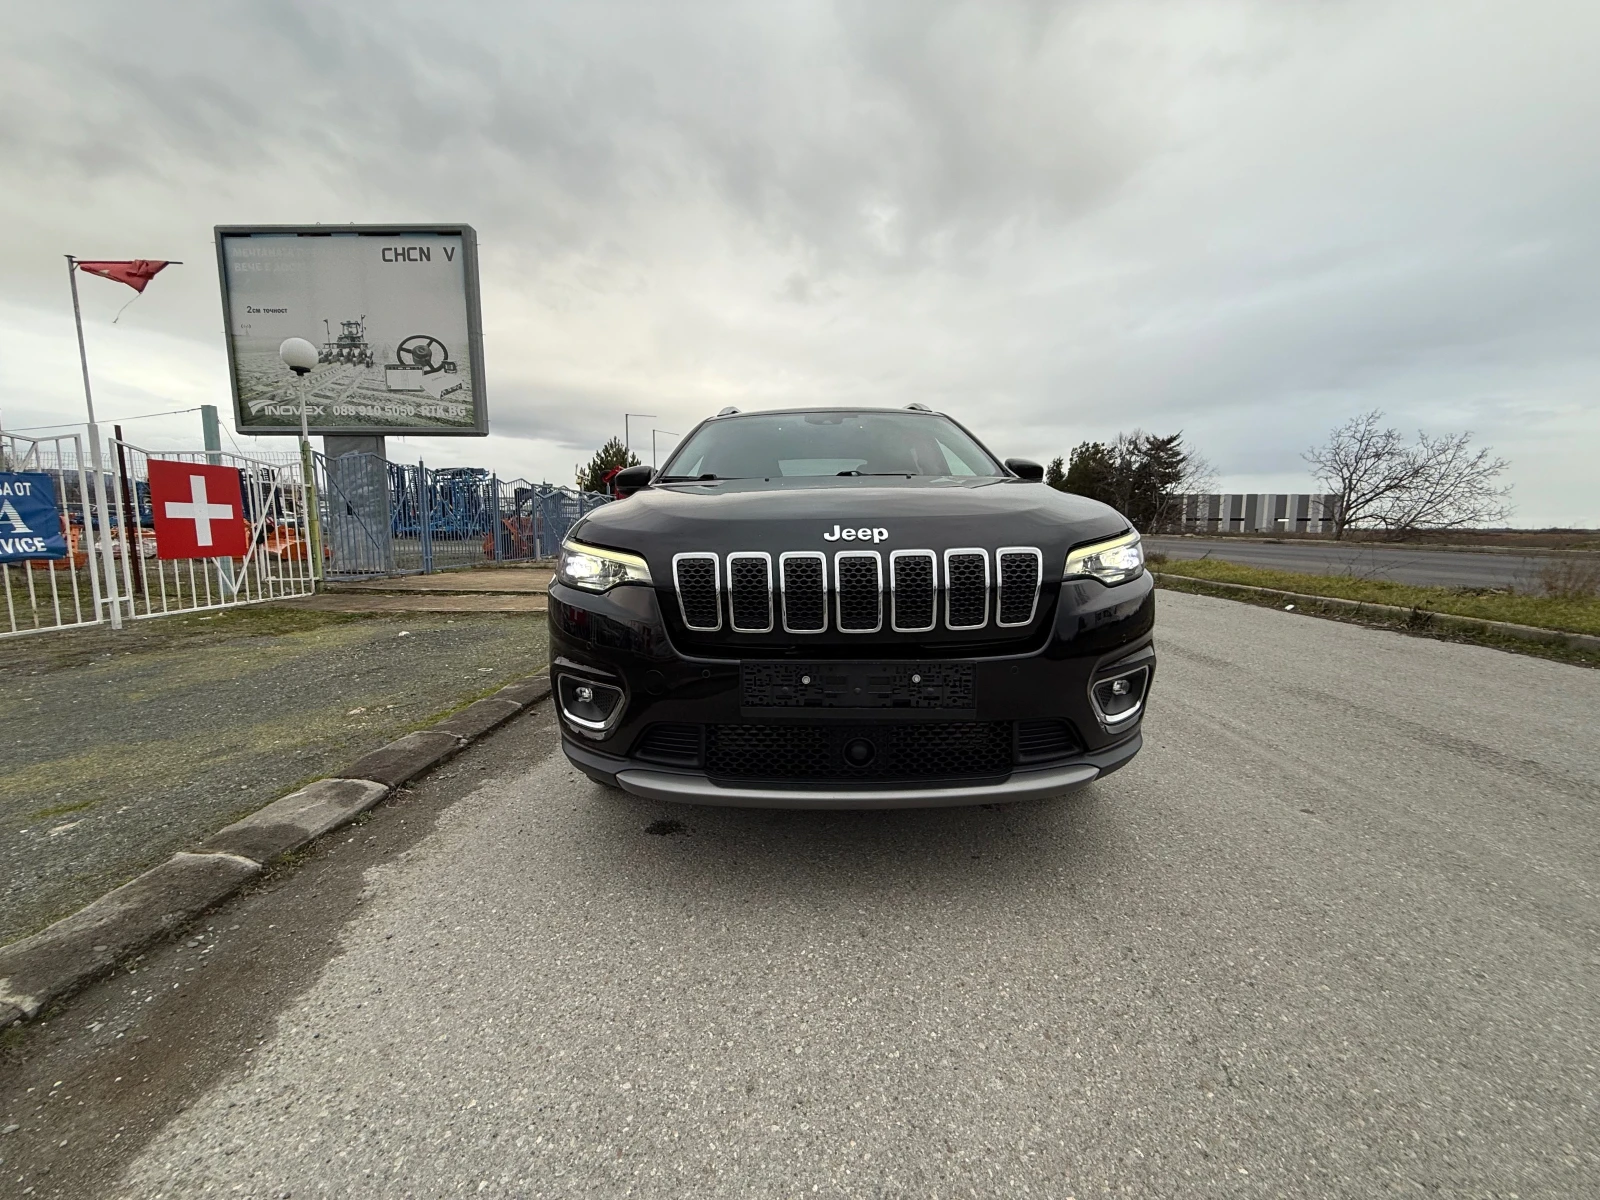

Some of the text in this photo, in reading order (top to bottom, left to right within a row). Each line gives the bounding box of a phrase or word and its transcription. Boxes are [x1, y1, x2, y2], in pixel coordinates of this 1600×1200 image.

[264, 405, 326, 416] INOVEX
[332, 405, 356, 416] 088
[384, 405, 415, 416] 5050
[0, 482, 32, 496] А ОТ
[823, 524, 889, 544] Jeep
[0, 536, 47, 555] VICE
